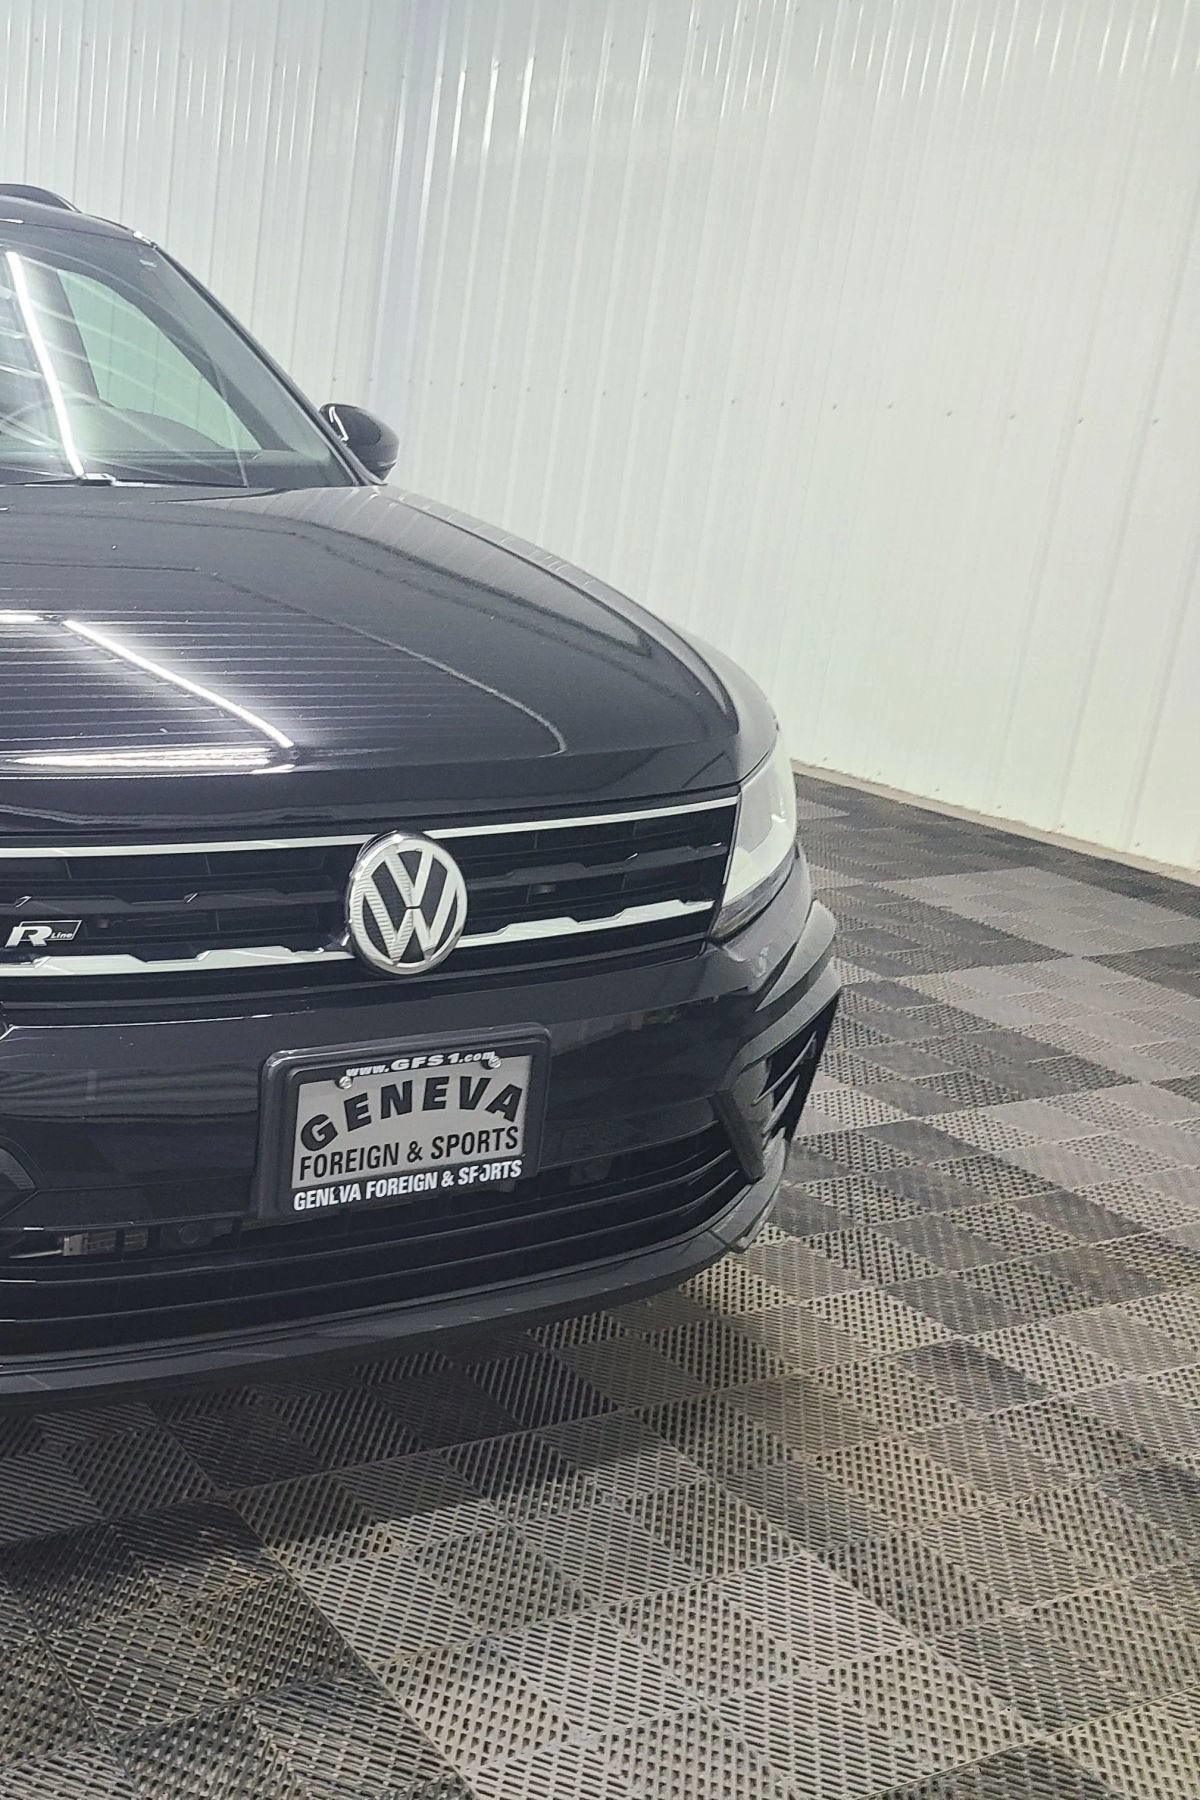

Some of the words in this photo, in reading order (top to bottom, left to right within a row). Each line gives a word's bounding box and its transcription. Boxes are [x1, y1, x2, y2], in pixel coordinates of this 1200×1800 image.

[5, 925, 53, 948] R
[300, 1075, 523, 1152] GENEVA
[300, 1142, 400, 1181] FOREIGN
[407, 1140, 424, 1163] &
[430, 1125, 519, 1160] SPORTS
[365, 1171, 439, 1200] FOREIGN
[440, 1170, 455, 1188] &
